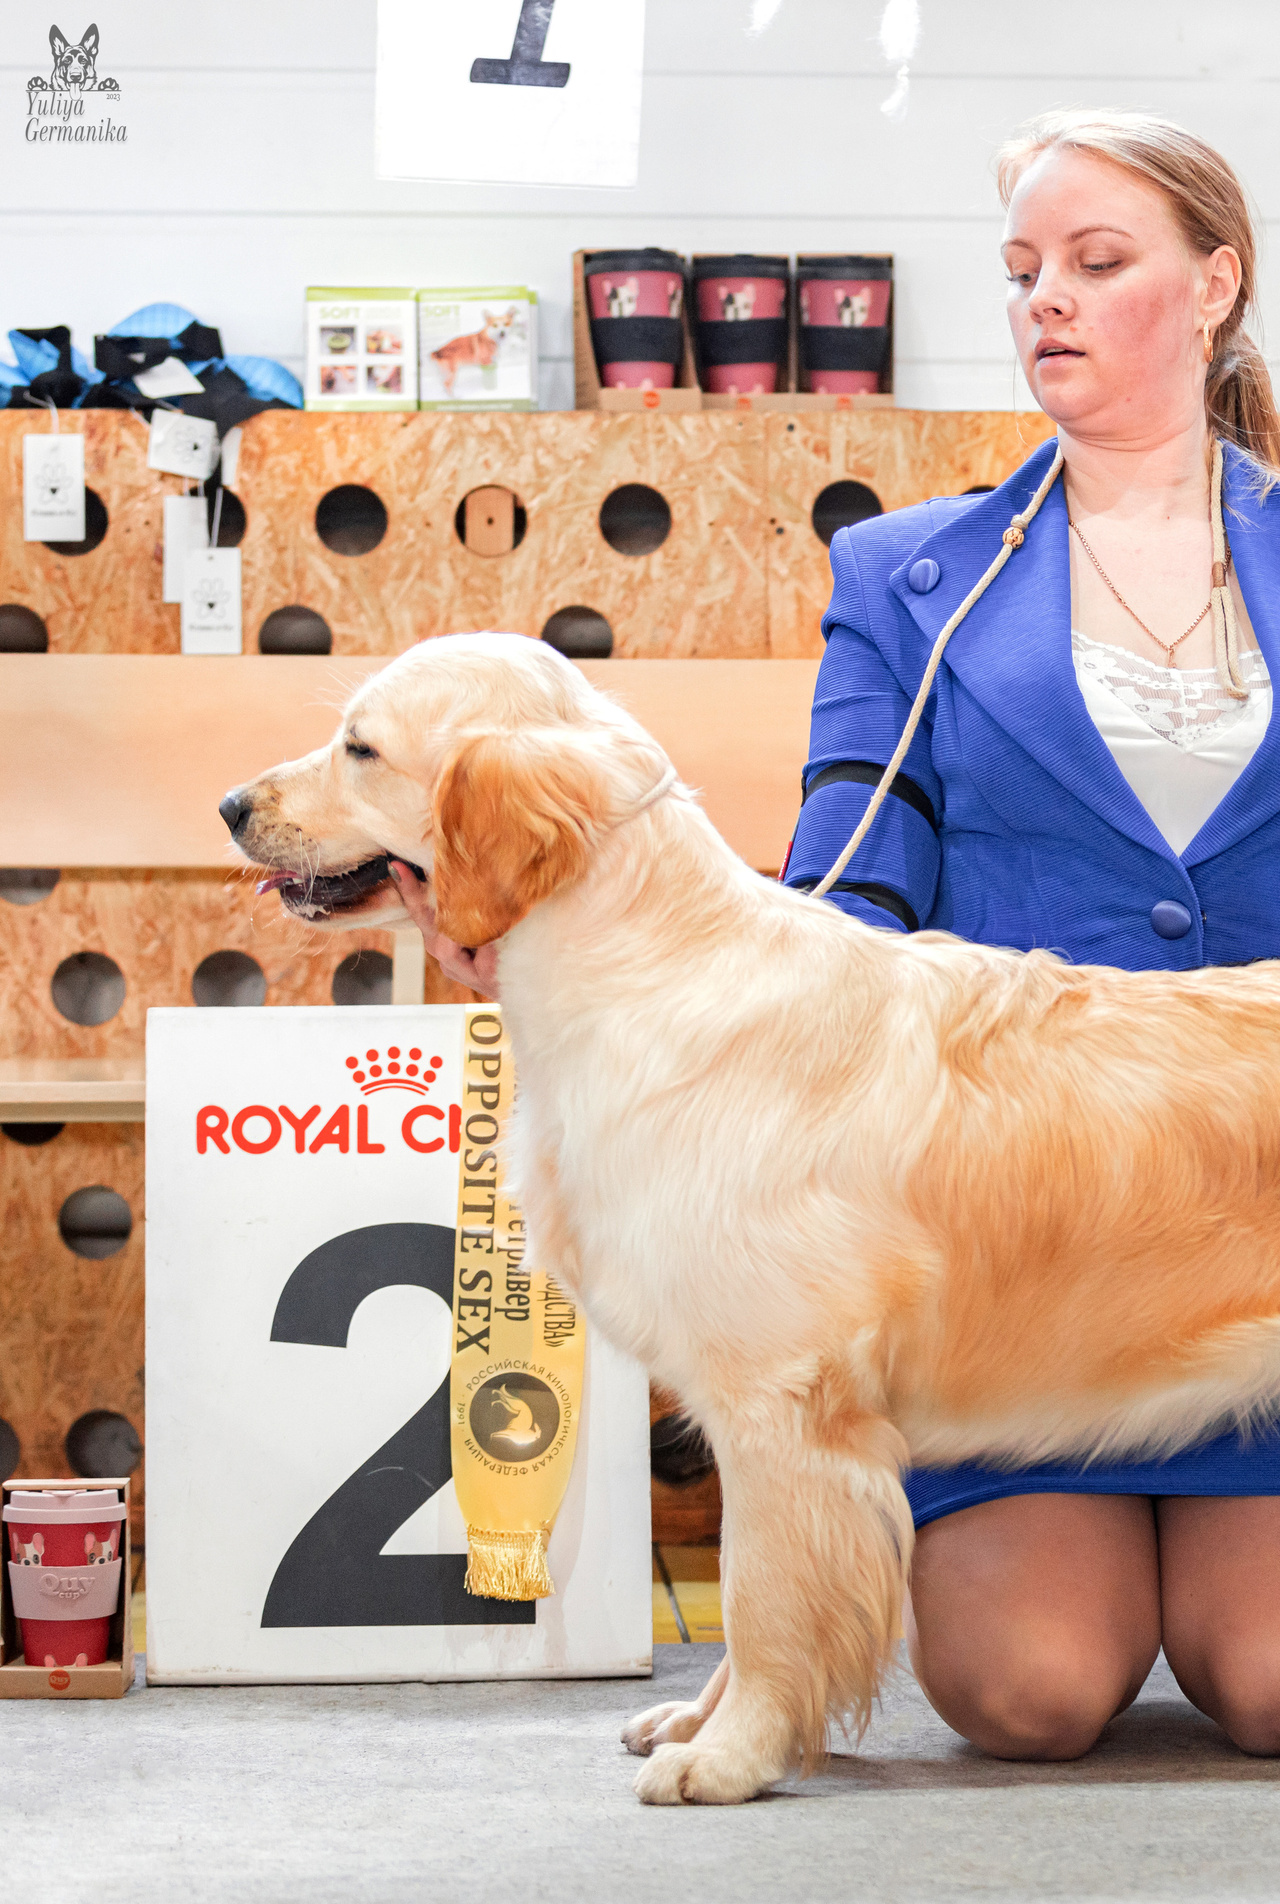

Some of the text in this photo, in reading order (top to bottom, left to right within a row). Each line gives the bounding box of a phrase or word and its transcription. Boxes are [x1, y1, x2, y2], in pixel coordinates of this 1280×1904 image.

[319, 306, 360, 320] SOFT
[197, 1104, 385, 1154] ROYAL
[456, 1014, 503, 1355] OPPOSITE SEX
[260, 1222, 536, 1628] 2
[457, 1402, 466, 1425] 1991
[464, 1358, 573, 1476] РОССИЙСКАЯ КИНОЛОГИЧЕСКАЯ ФЕДЕРАЦИЯ
[39, 1573, 96, 1597] Quy
